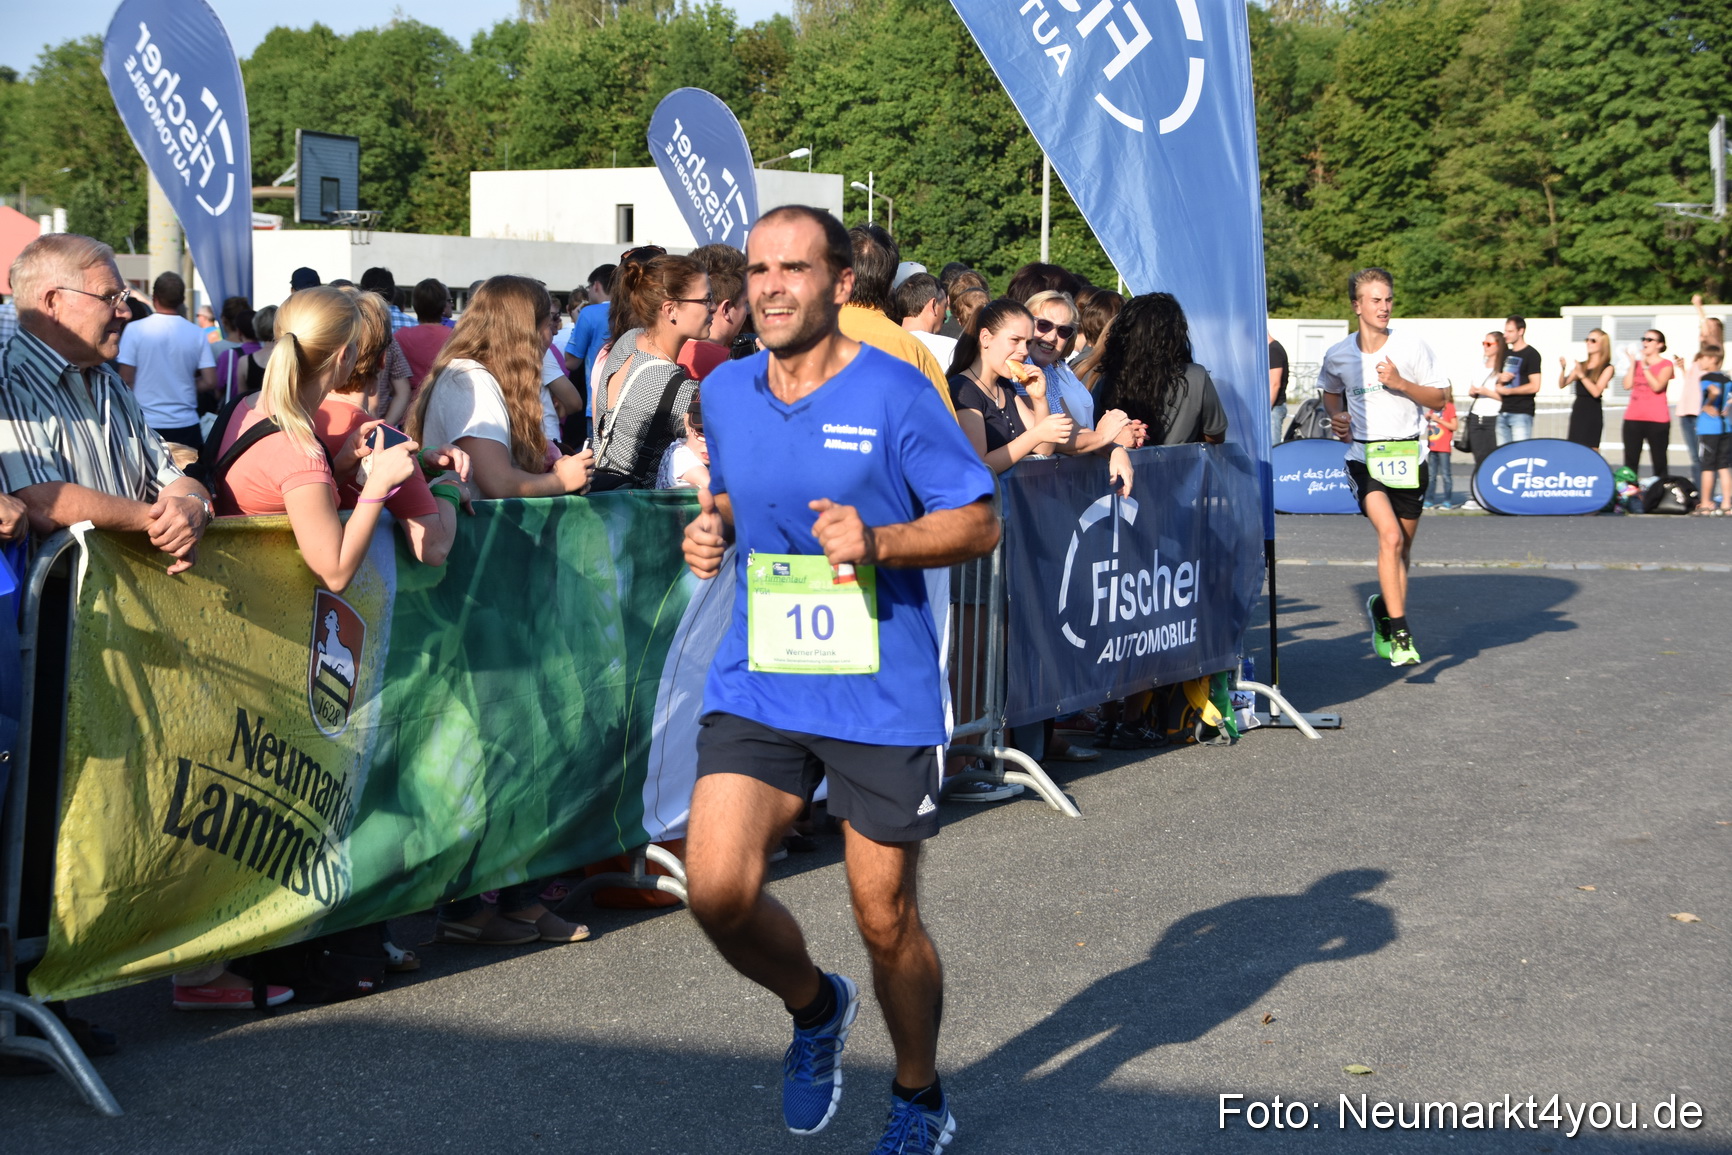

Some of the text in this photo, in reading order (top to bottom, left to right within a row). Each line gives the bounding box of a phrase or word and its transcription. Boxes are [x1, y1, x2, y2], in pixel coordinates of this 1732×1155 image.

[824, 438, 859, 451] Allianz
[1279, 470, 1301, 482] und
[1303, 468, 1323, 479] das
[1377, 460, 1407, 475] 113
[1512, 472, 1599, 489] Fischer
[1521, 490, 1593, 498] AUTOMOBILE
[786, 603, 835, 641] 10
[1097, 617, 1198, 664] AUTOMOBILE
[785, 648, 813, 656] Werner
[317, 697, 341, 727] 1628
